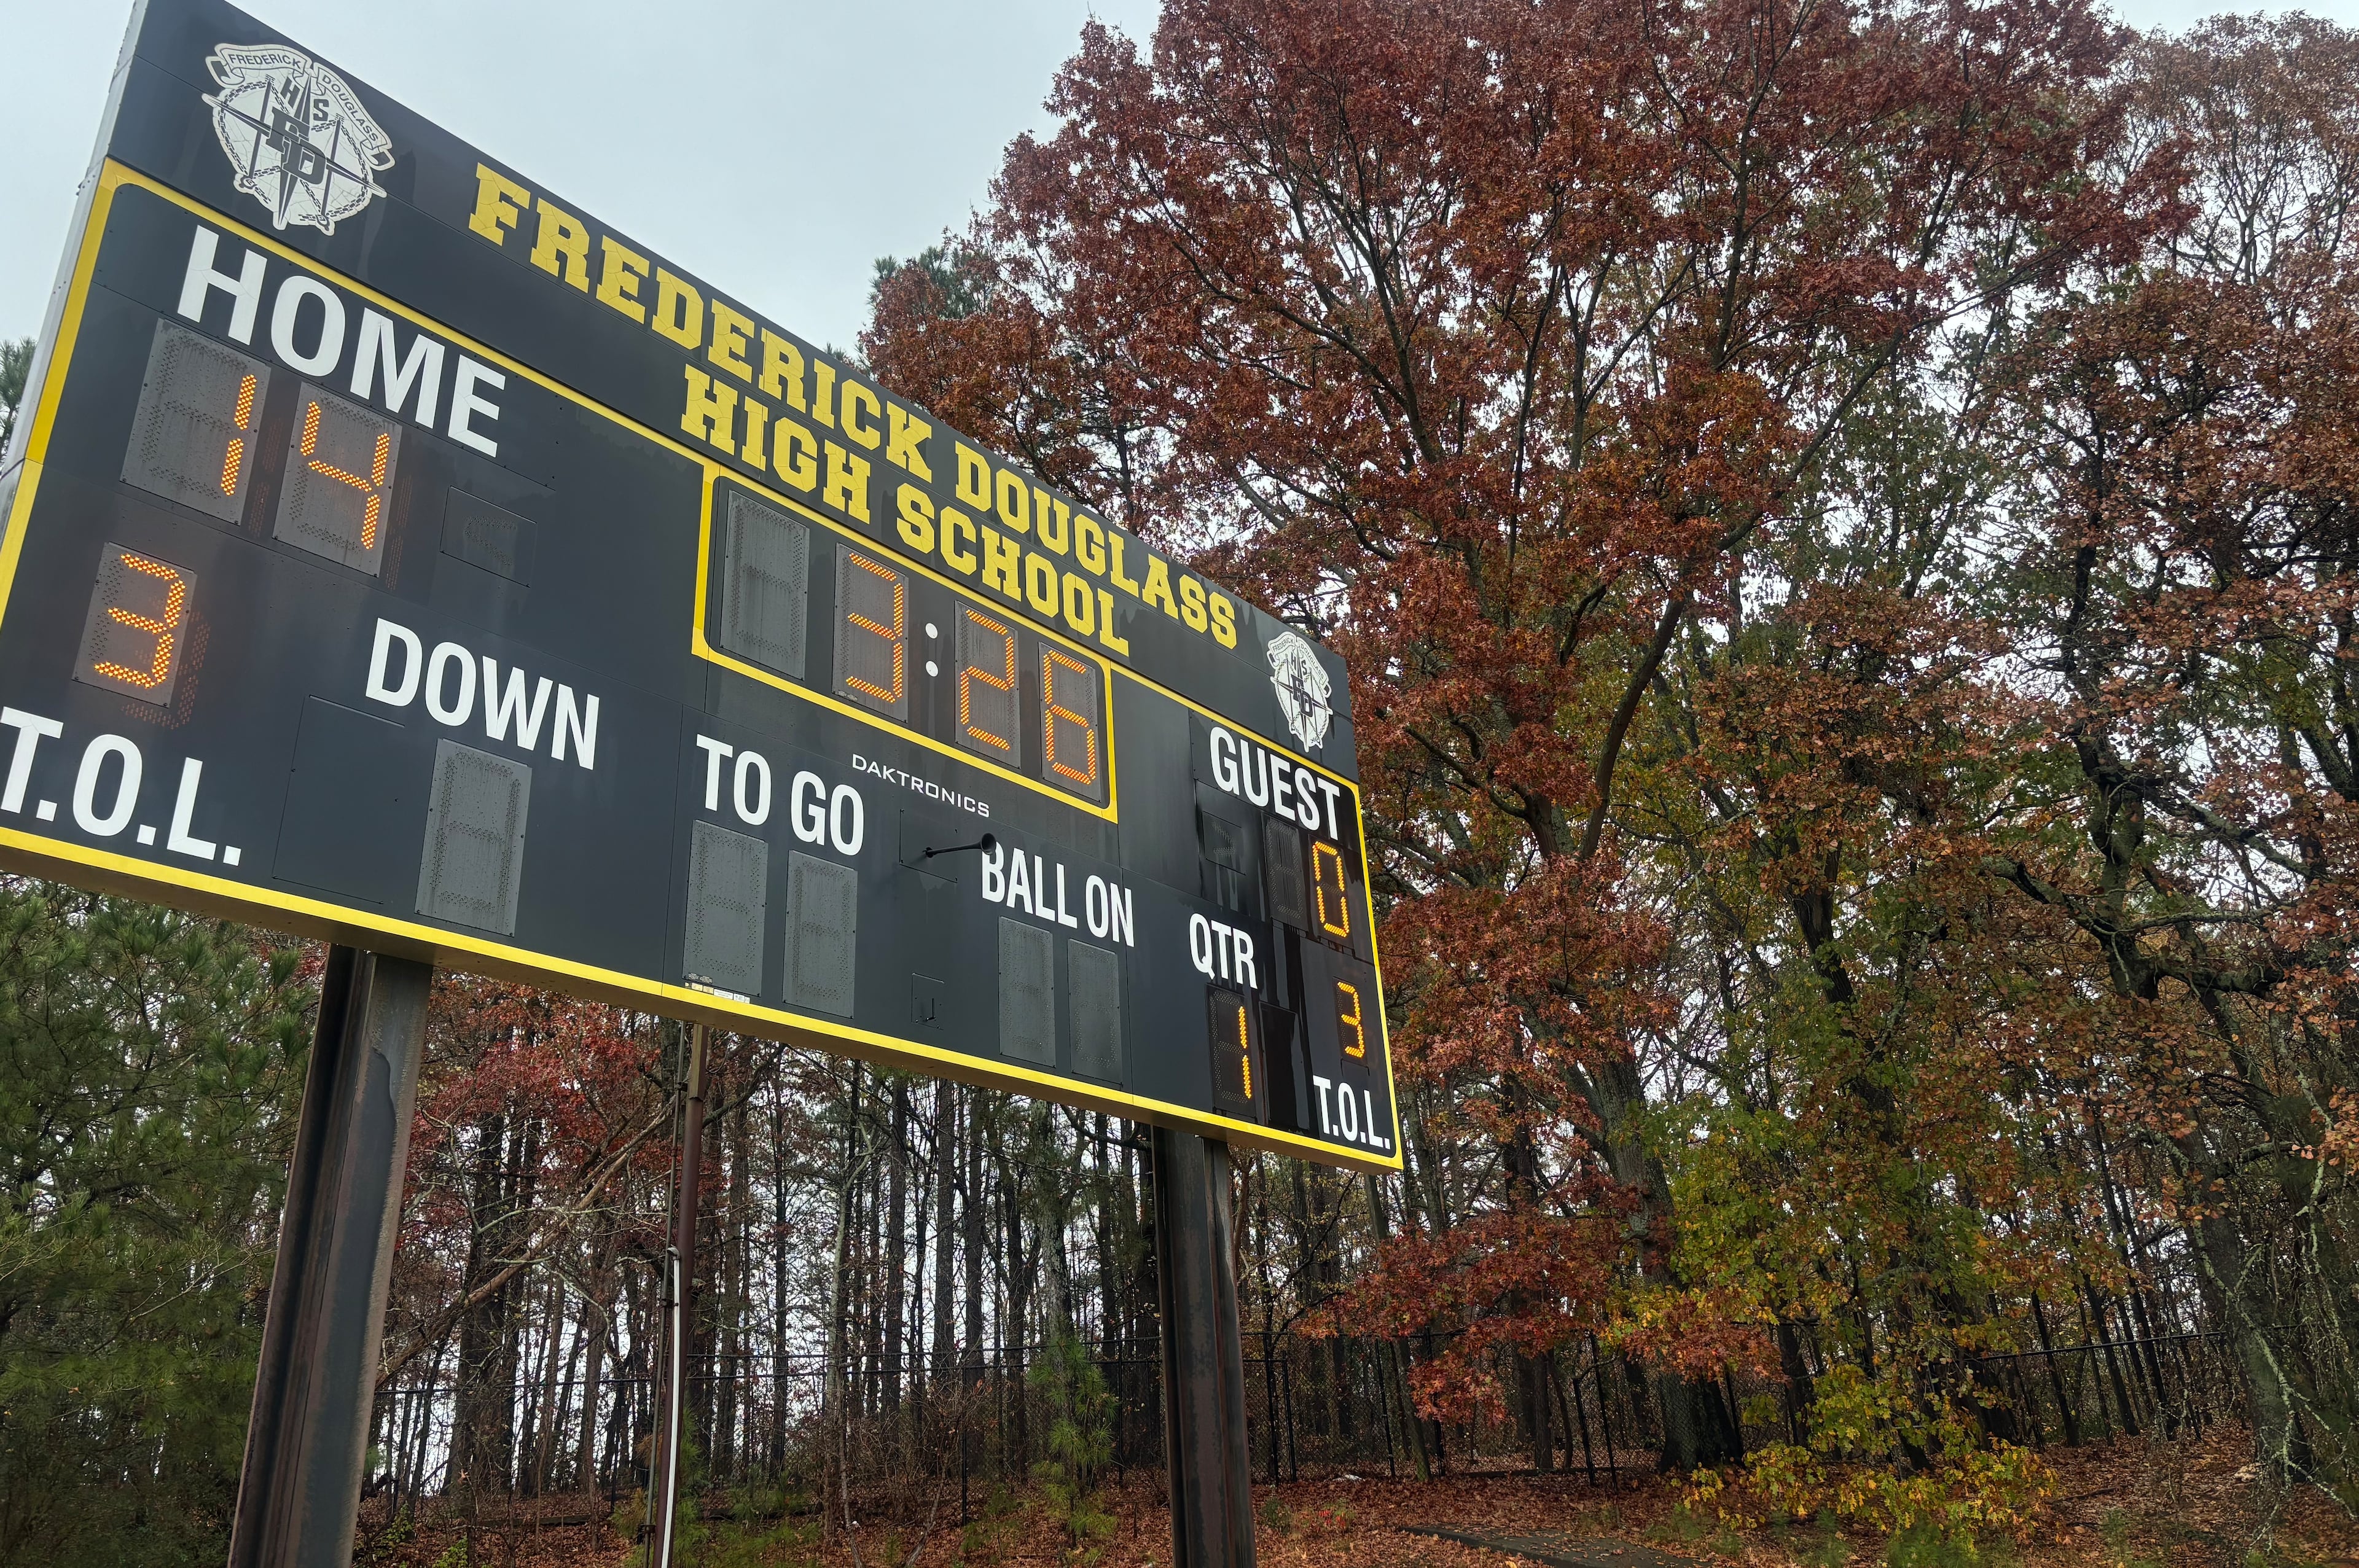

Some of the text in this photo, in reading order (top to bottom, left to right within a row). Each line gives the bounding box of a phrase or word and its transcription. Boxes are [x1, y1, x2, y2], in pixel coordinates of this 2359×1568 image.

[229, 53, 378, 142] FREDERICK DOUGLASS
[176, 224, 506, 458] HOME
[220, 373, 389, 550] 14
[468, 162, 1237, 650] FREDERICK DOUGLASS
[681, 364, 1130, 658] HIGH SCHOOL
[93, 553, 186, 689] 3
[846, 552, 1096, 785] 3:26
[1272, 637, 1324, 679] FREDERICK DOUGLASS
[366, 617, 600, 770] DOWN
[0, 706, 241, 866] T.O.L.
[696, 734, 864, 856] TO GO
[852, 754, 990, 817] DAKTRONICS
[1210, 726, 1340, 840] GUEST
[982, 841, 1135, 948] BALL ON
[1312, 840, 1349, 937] 0
[1189, 913, 1258, 989] QTR
[1238, 1005, 1252, 1099] 1
[1337, 981, 1365, 1058] 3
[1313, 1075, 1391, 1150] T.O.L.
